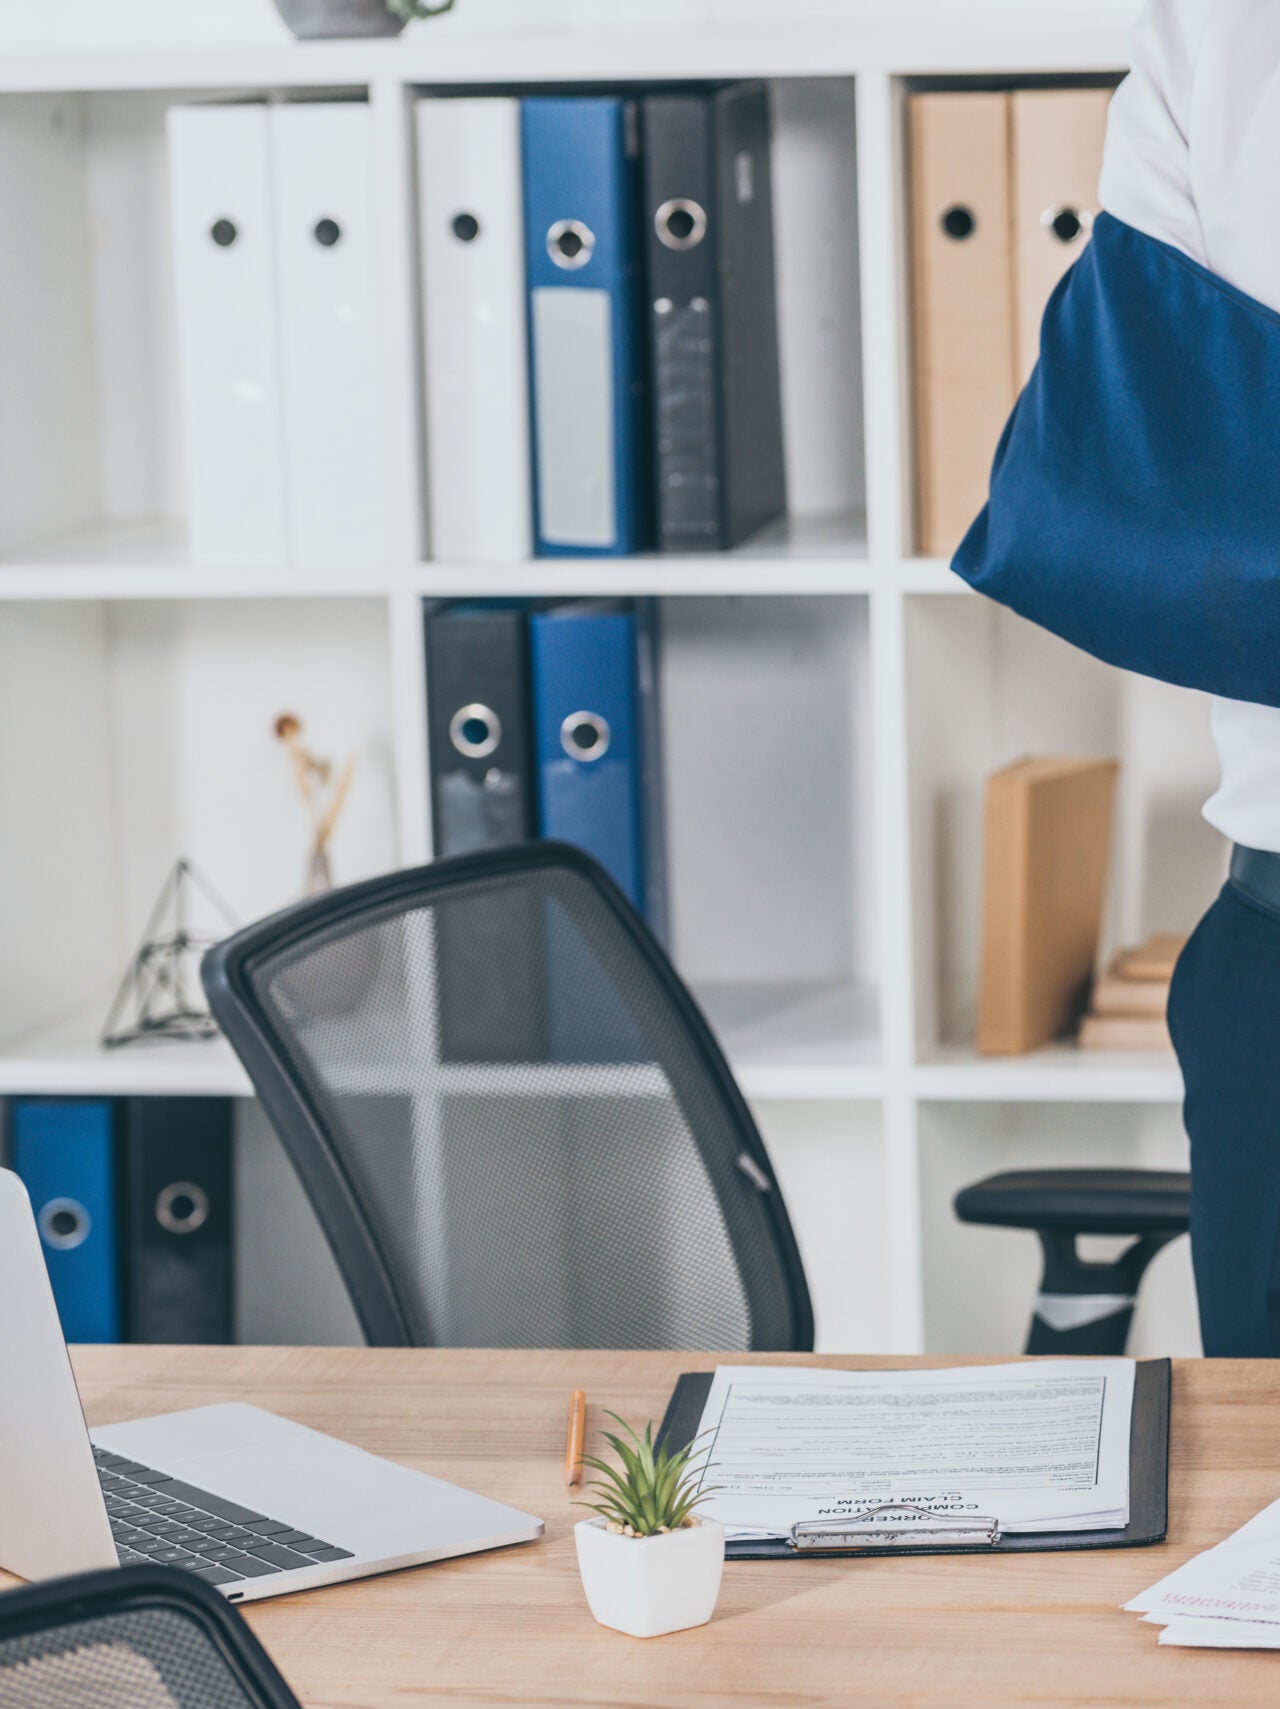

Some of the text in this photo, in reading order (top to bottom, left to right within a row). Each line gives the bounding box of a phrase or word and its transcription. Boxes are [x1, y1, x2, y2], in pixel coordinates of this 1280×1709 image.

[837, 1497, 894, 1505] FORM
[901, 1495, 963, 1503] CLAIM
[818, 1503, 979, 1515] COMPATION
